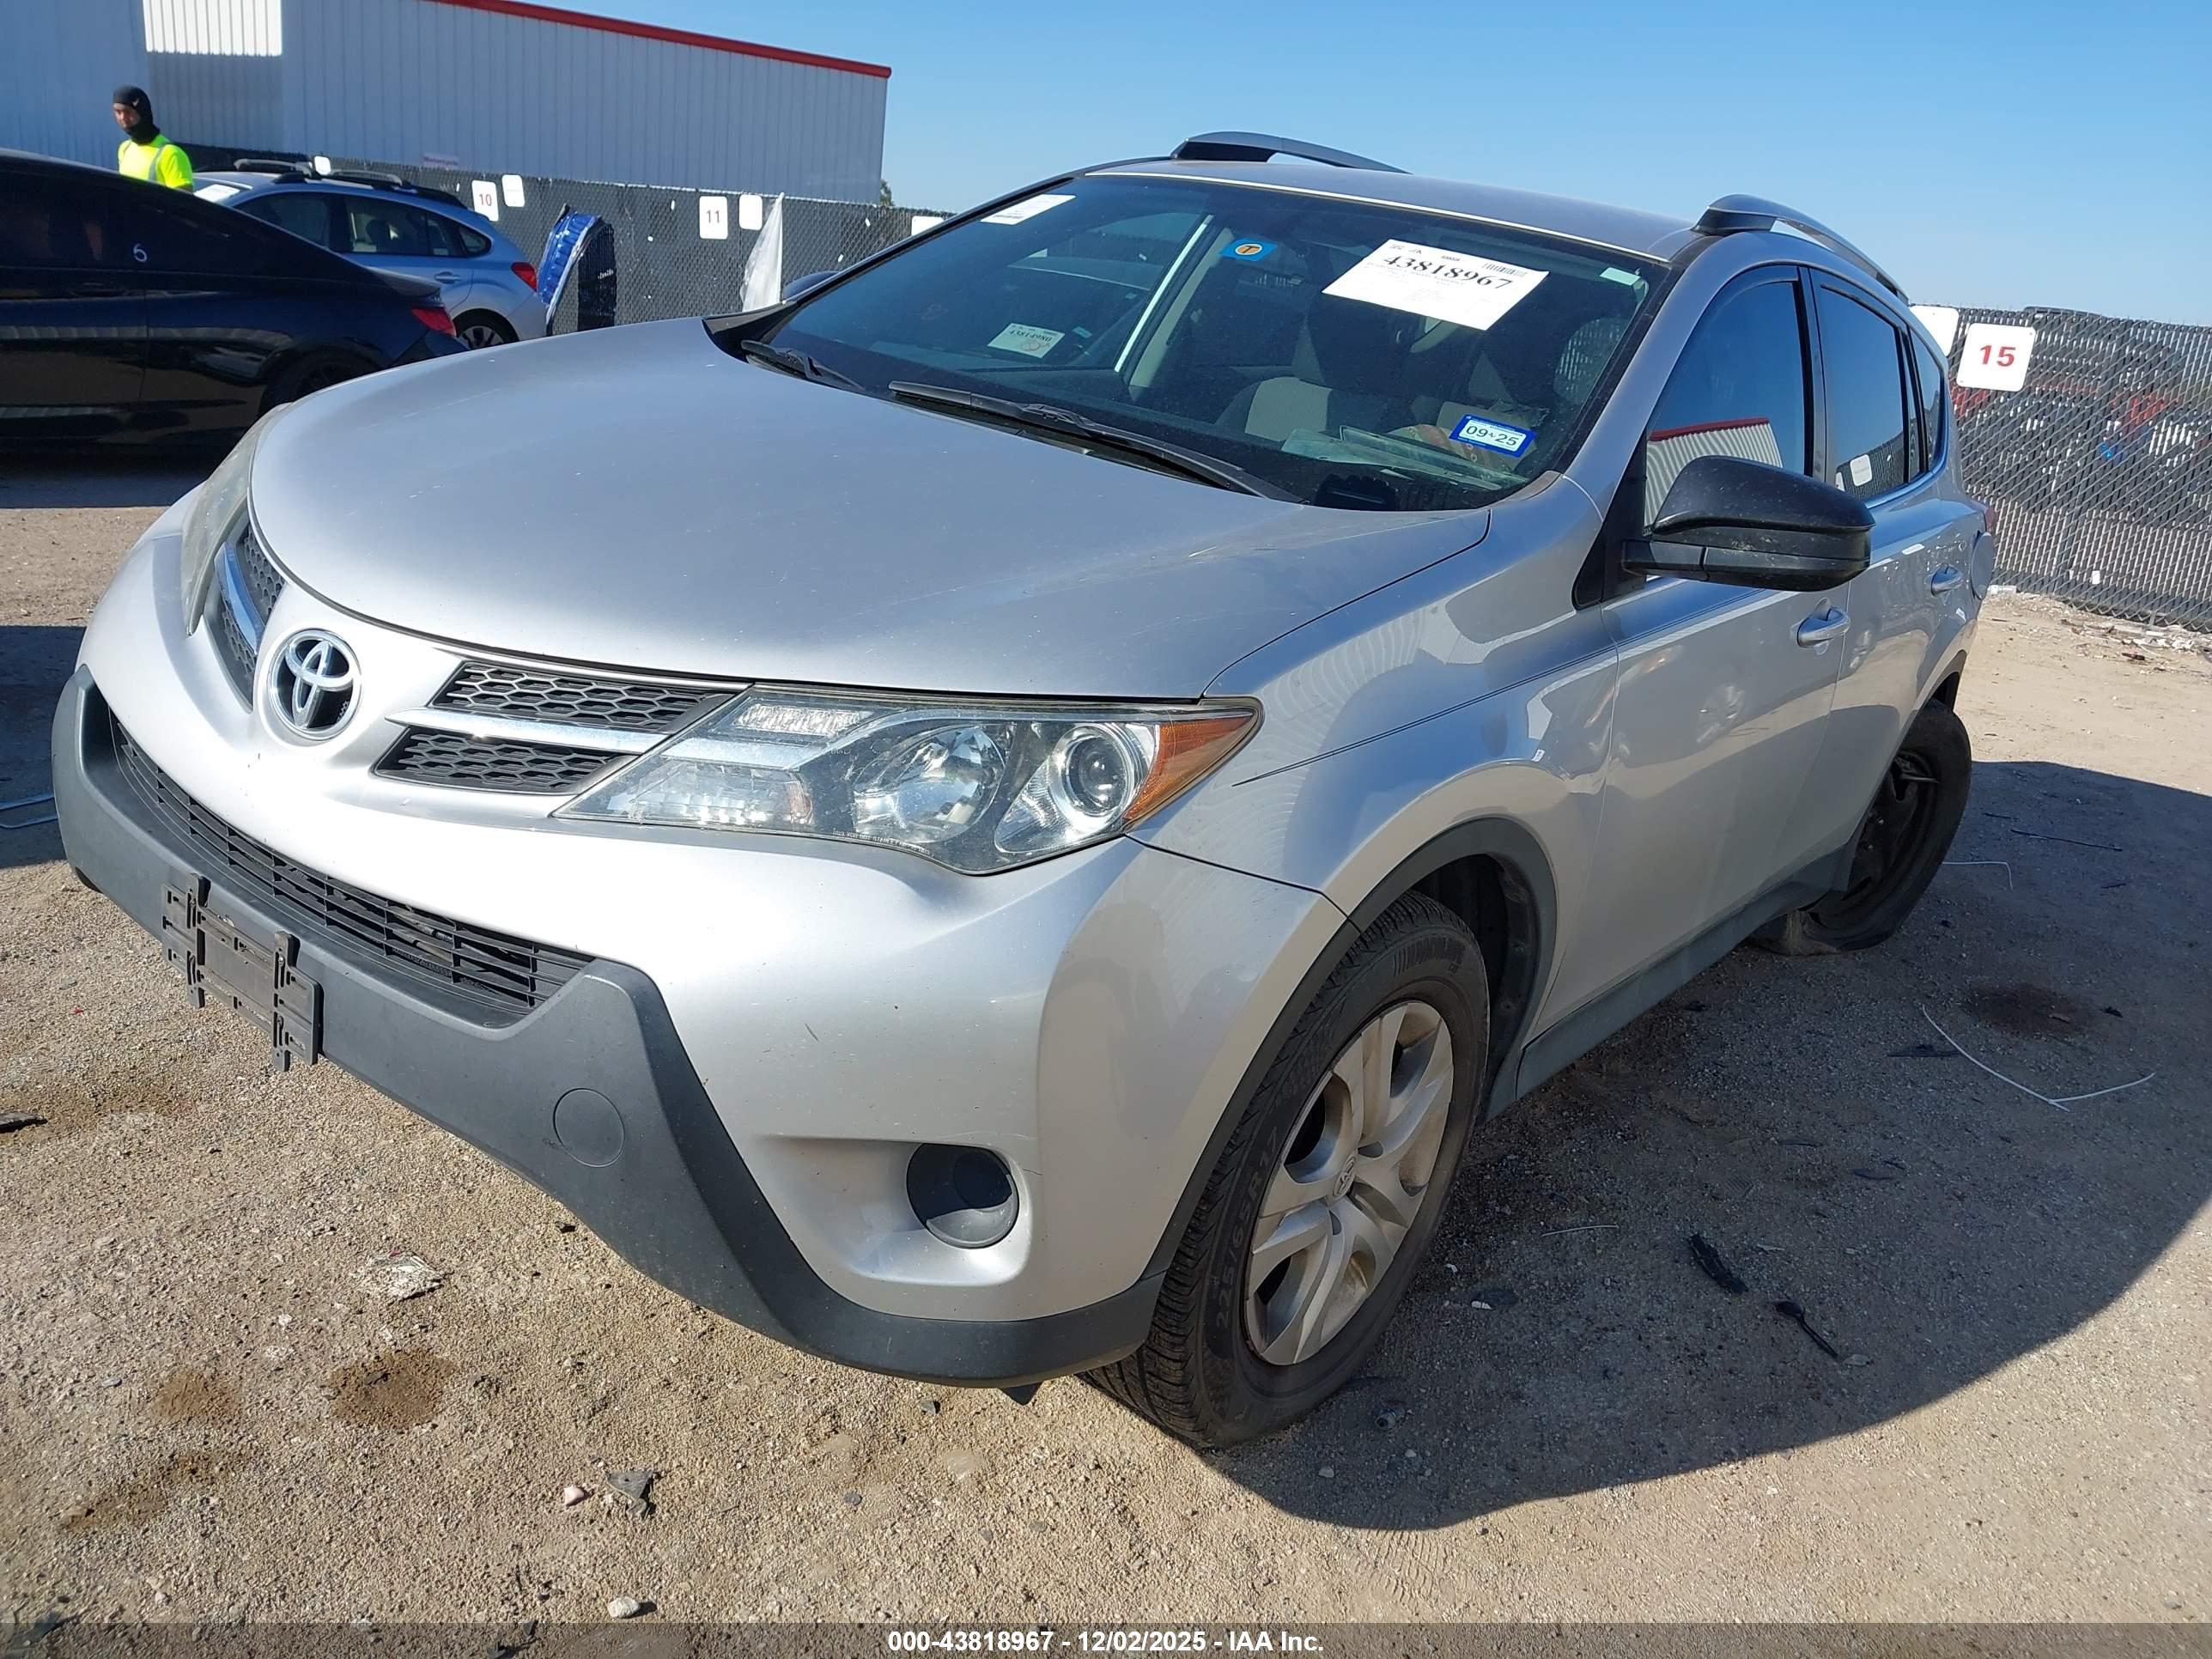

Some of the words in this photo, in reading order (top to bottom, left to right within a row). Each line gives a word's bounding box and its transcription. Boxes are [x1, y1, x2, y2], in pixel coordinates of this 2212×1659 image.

[478, 193, 493, 207] 10
[706, 210, 720, 224] 11
[133, 243, 147, 262] 6
[1382, 255, 1513, 289] 43818967
[1979, 344, 2016, 367] 15
[1465, 425, 1488, 438] 09
[1494, 433, 1520, 446] 25
